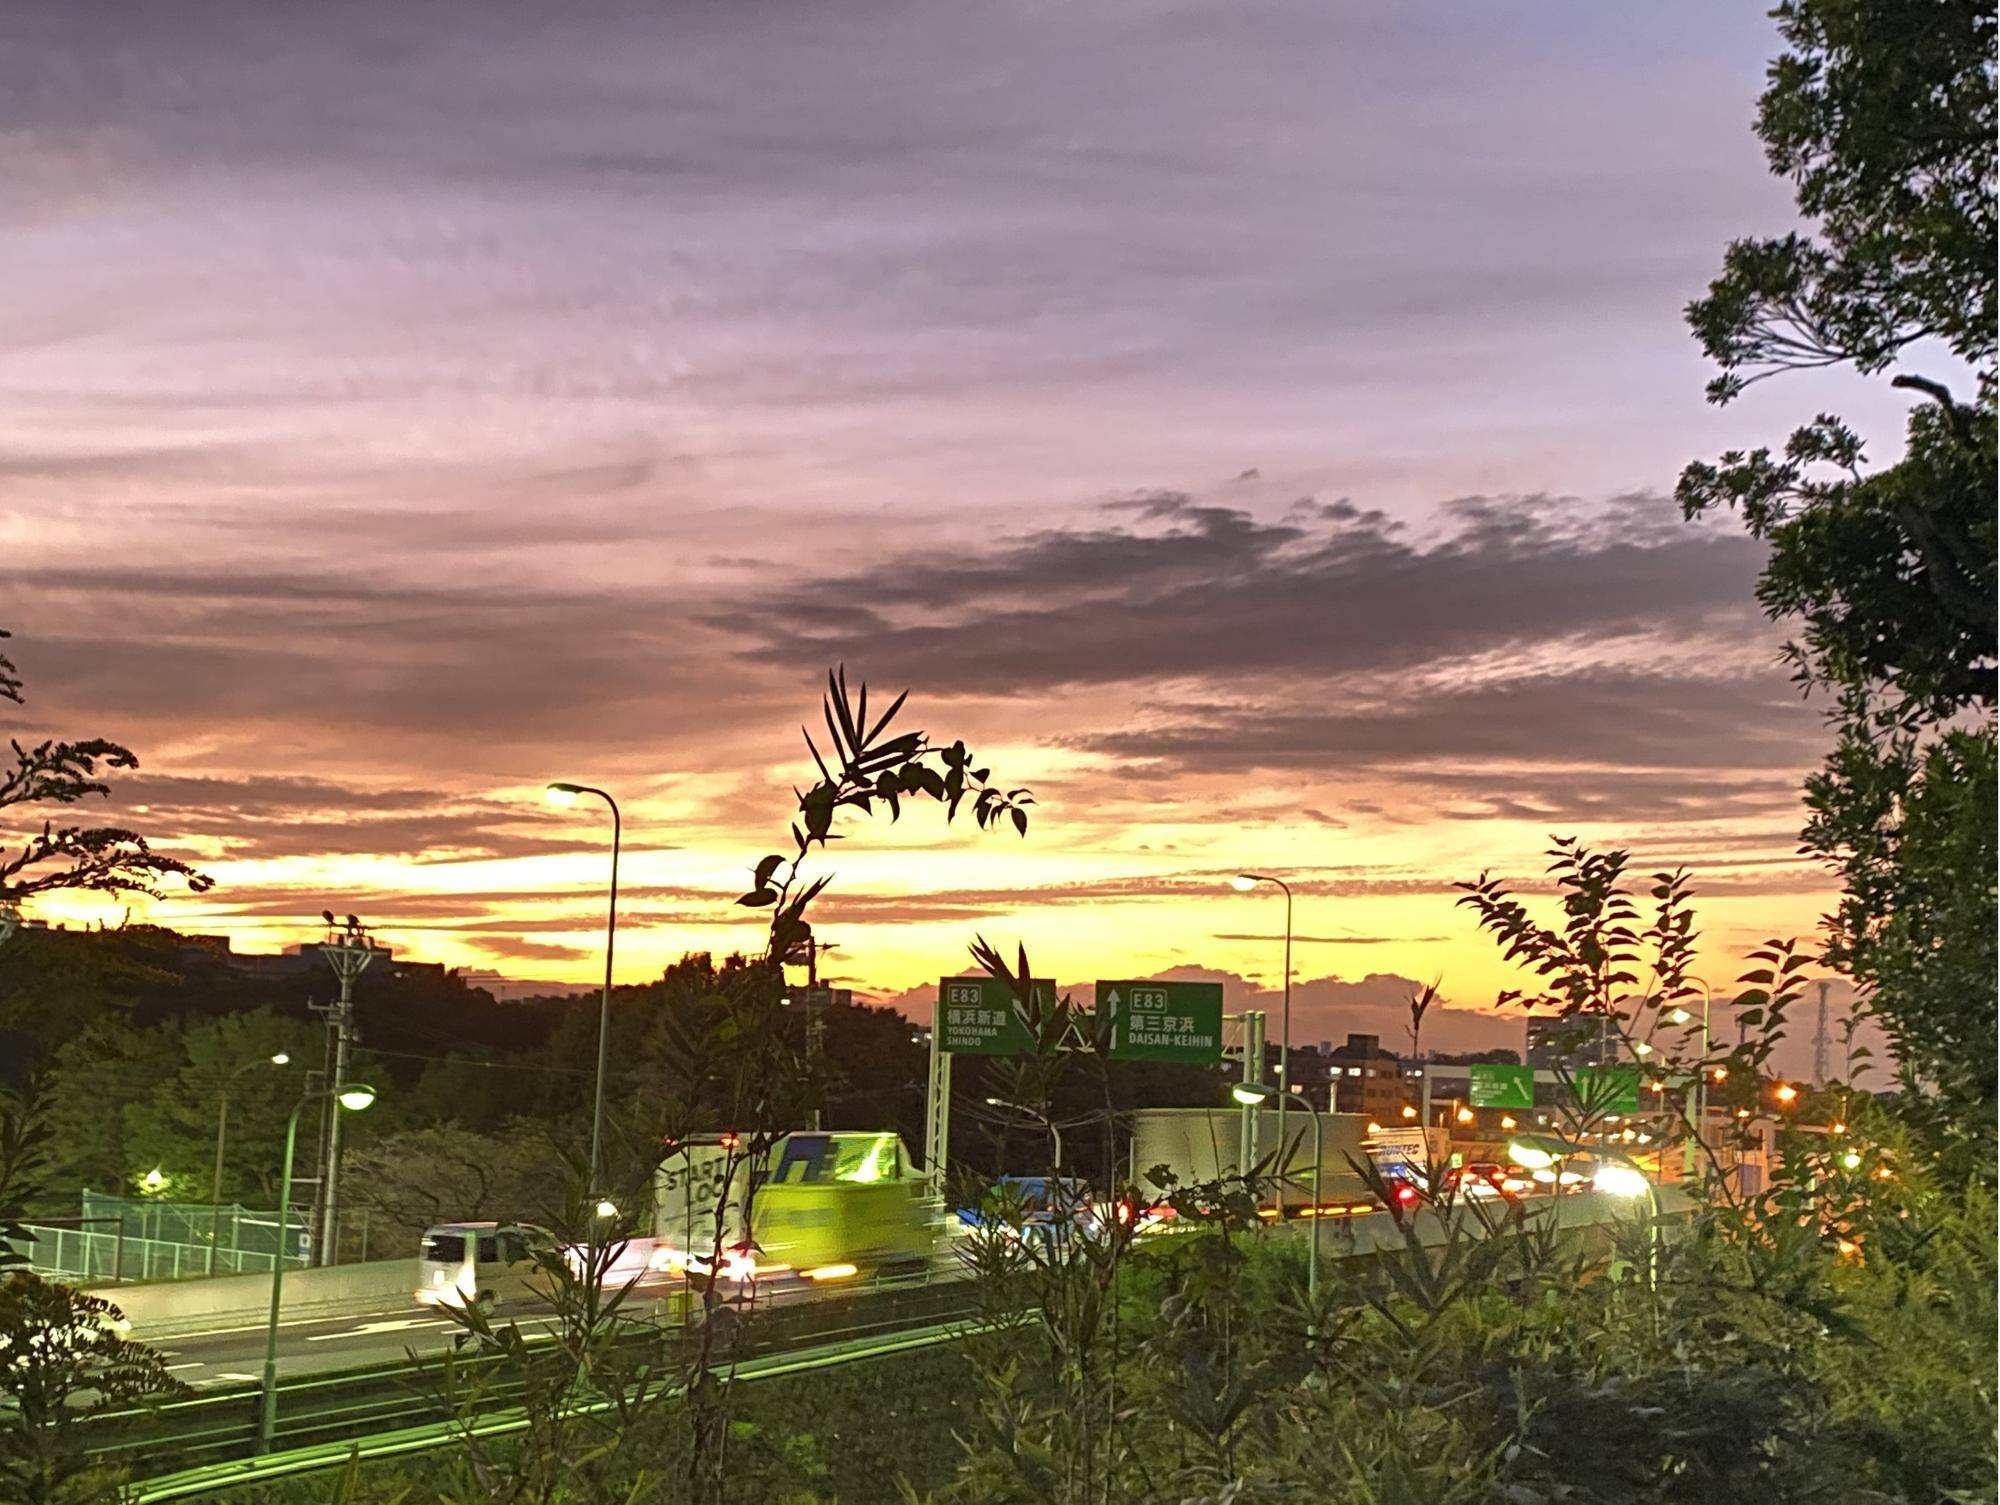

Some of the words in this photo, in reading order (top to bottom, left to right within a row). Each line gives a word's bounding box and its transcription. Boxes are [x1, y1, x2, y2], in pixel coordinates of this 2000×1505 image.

[951, 989, 979, 1003] E83
[1133, 993, 1164, 1009] E83
[947, 1009, 1008, 1026] 横浜新道
[1130, 1014, 1195, 1033] 第三京浜
[946, 1026, 998, 1036] YOKOHAMA
[946, 1036, 982, 1047] SHINDO
[1128, 1032, 1213, 1048] DAISAN-KEIHIN
